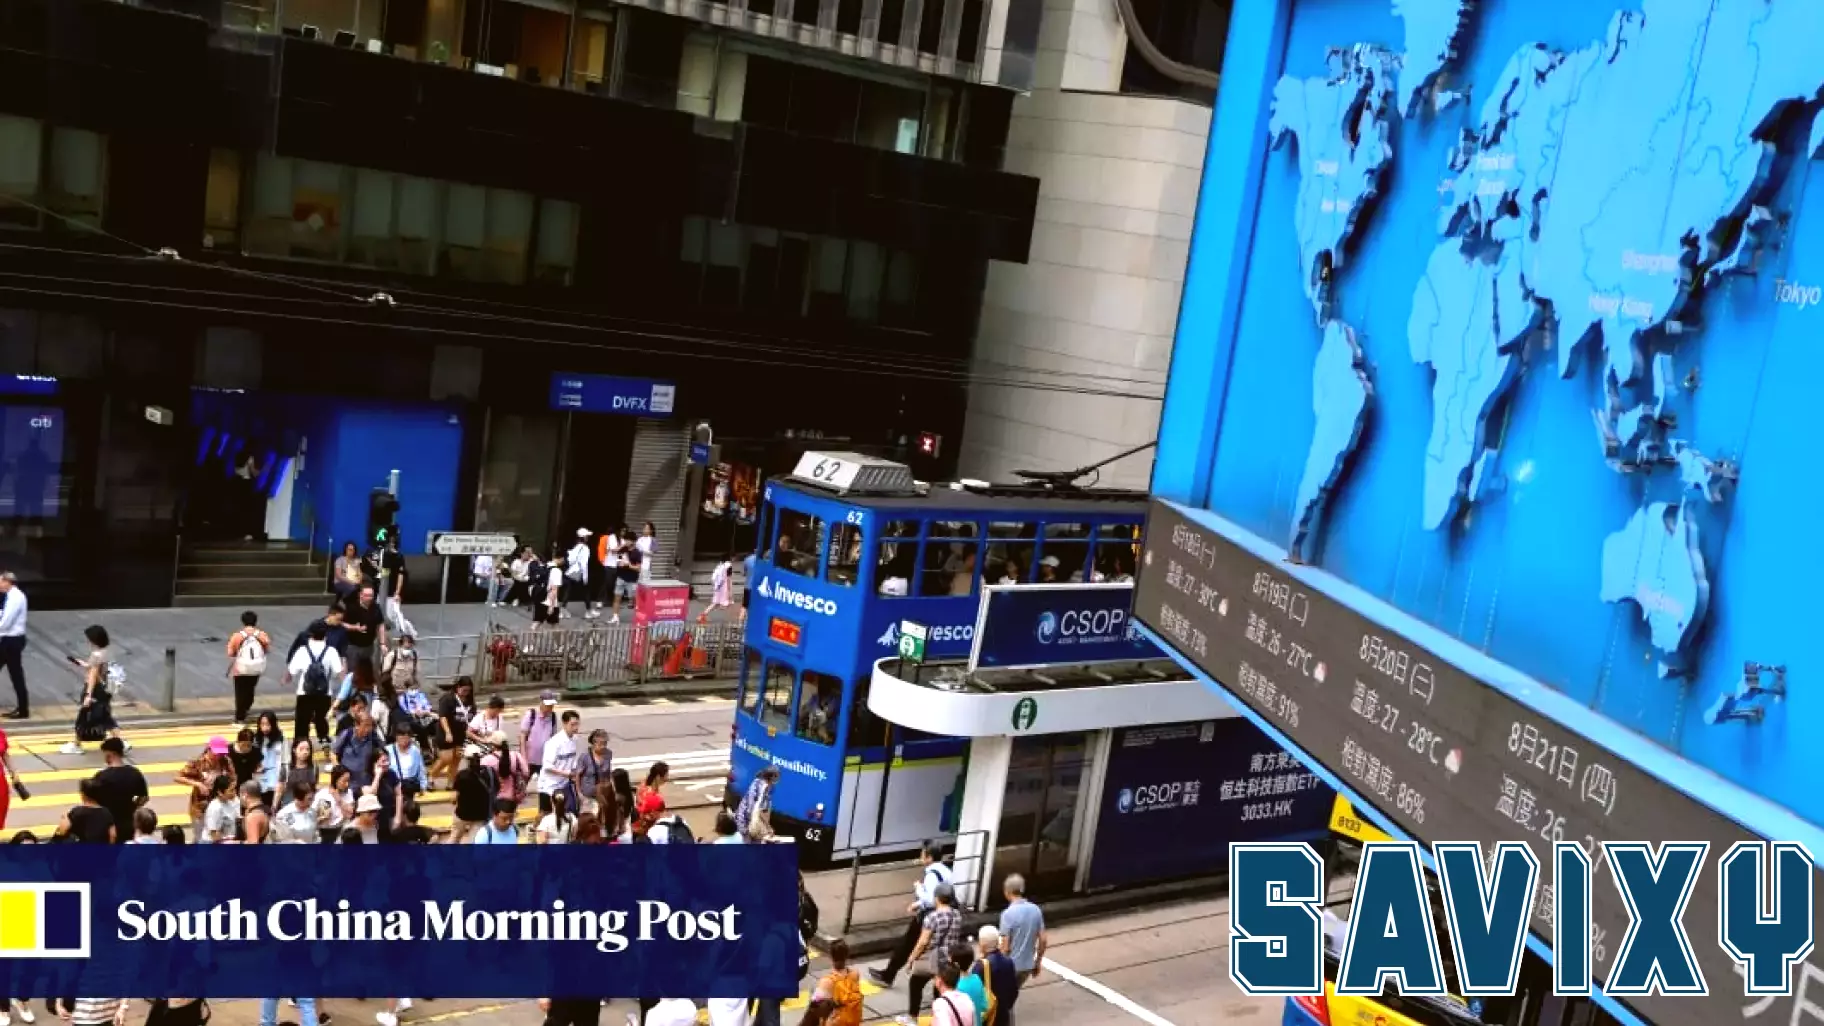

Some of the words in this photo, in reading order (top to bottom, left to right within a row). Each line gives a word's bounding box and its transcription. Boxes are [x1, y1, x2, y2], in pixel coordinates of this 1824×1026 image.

[1775, 278, 1822, 310] Tokyo
[813, 458, 841, 482] 62
[847, 510, 863, 526] 62
[1061, 609, 1124, 636] CSOP
[1381, 704, 1400, 734] 27
[771, 753, 828, 782] possibility.
[1135, 782, 1181, 806] CSOP
[1397, 783, 1426, 824] 86%
[1241, 799, 1297, 821] 3033.HK
[805, 828, 822, 841] 62
